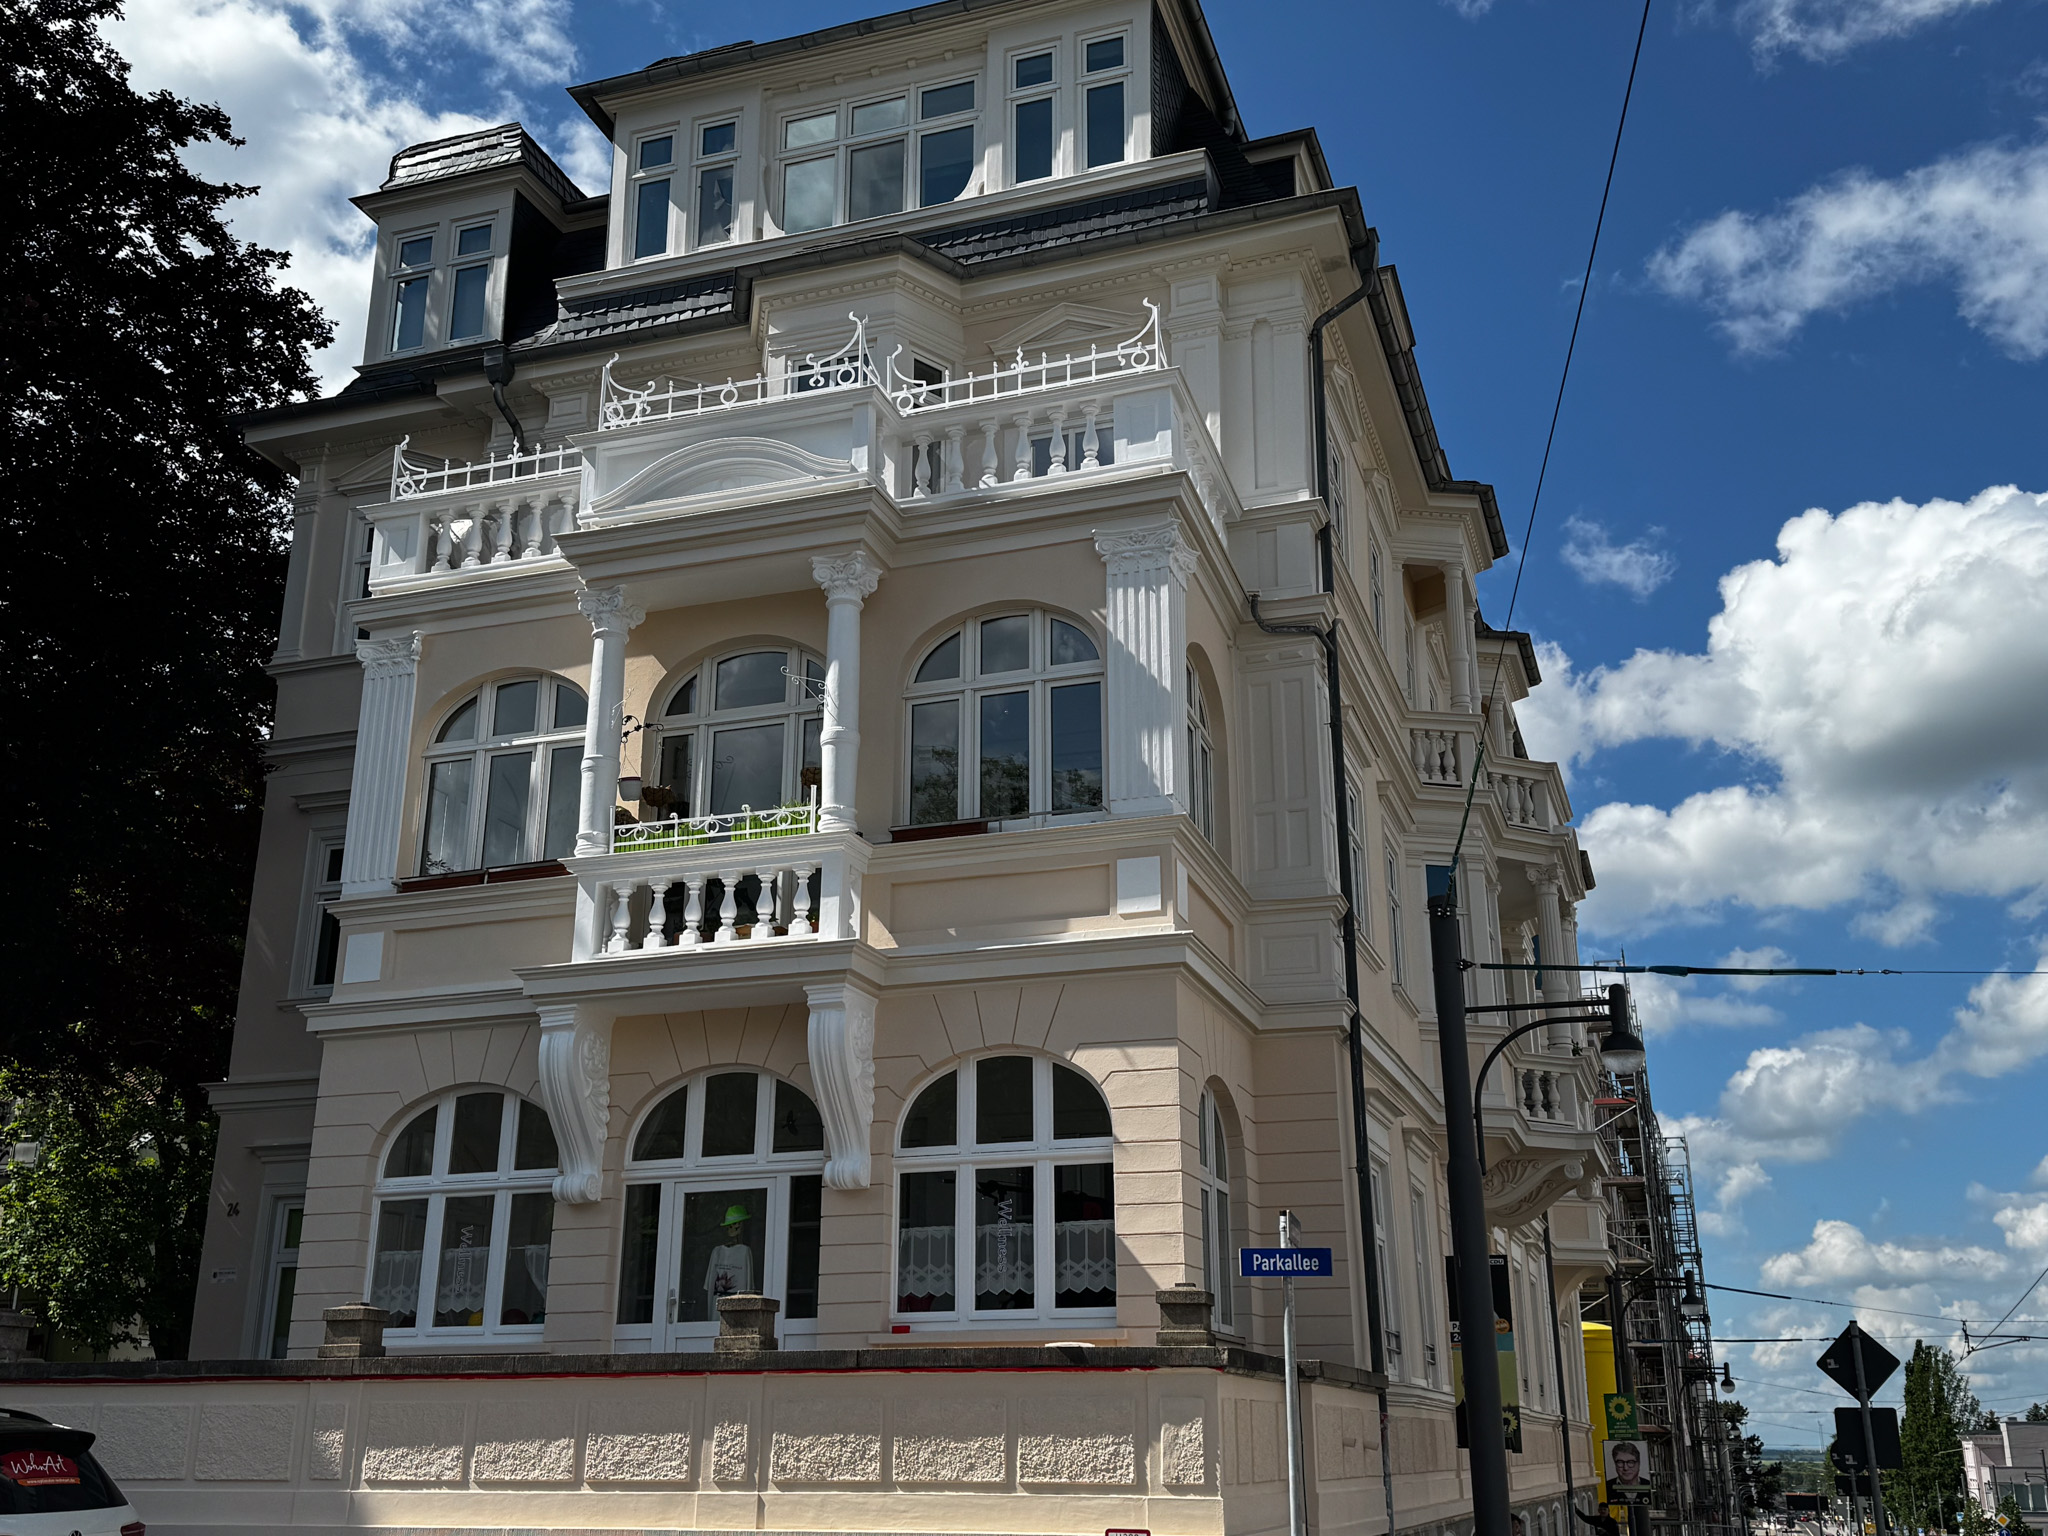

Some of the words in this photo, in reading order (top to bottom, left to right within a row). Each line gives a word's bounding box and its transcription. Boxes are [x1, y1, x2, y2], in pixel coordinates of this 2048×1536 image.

[454, 1224, 475, 1294] Wellness
[996, 1198, 1013, 1274] Wellness
[1252, 1253, 1320, 1271] Parkallee
[10, 1452, 68, 1475] WohnArt
